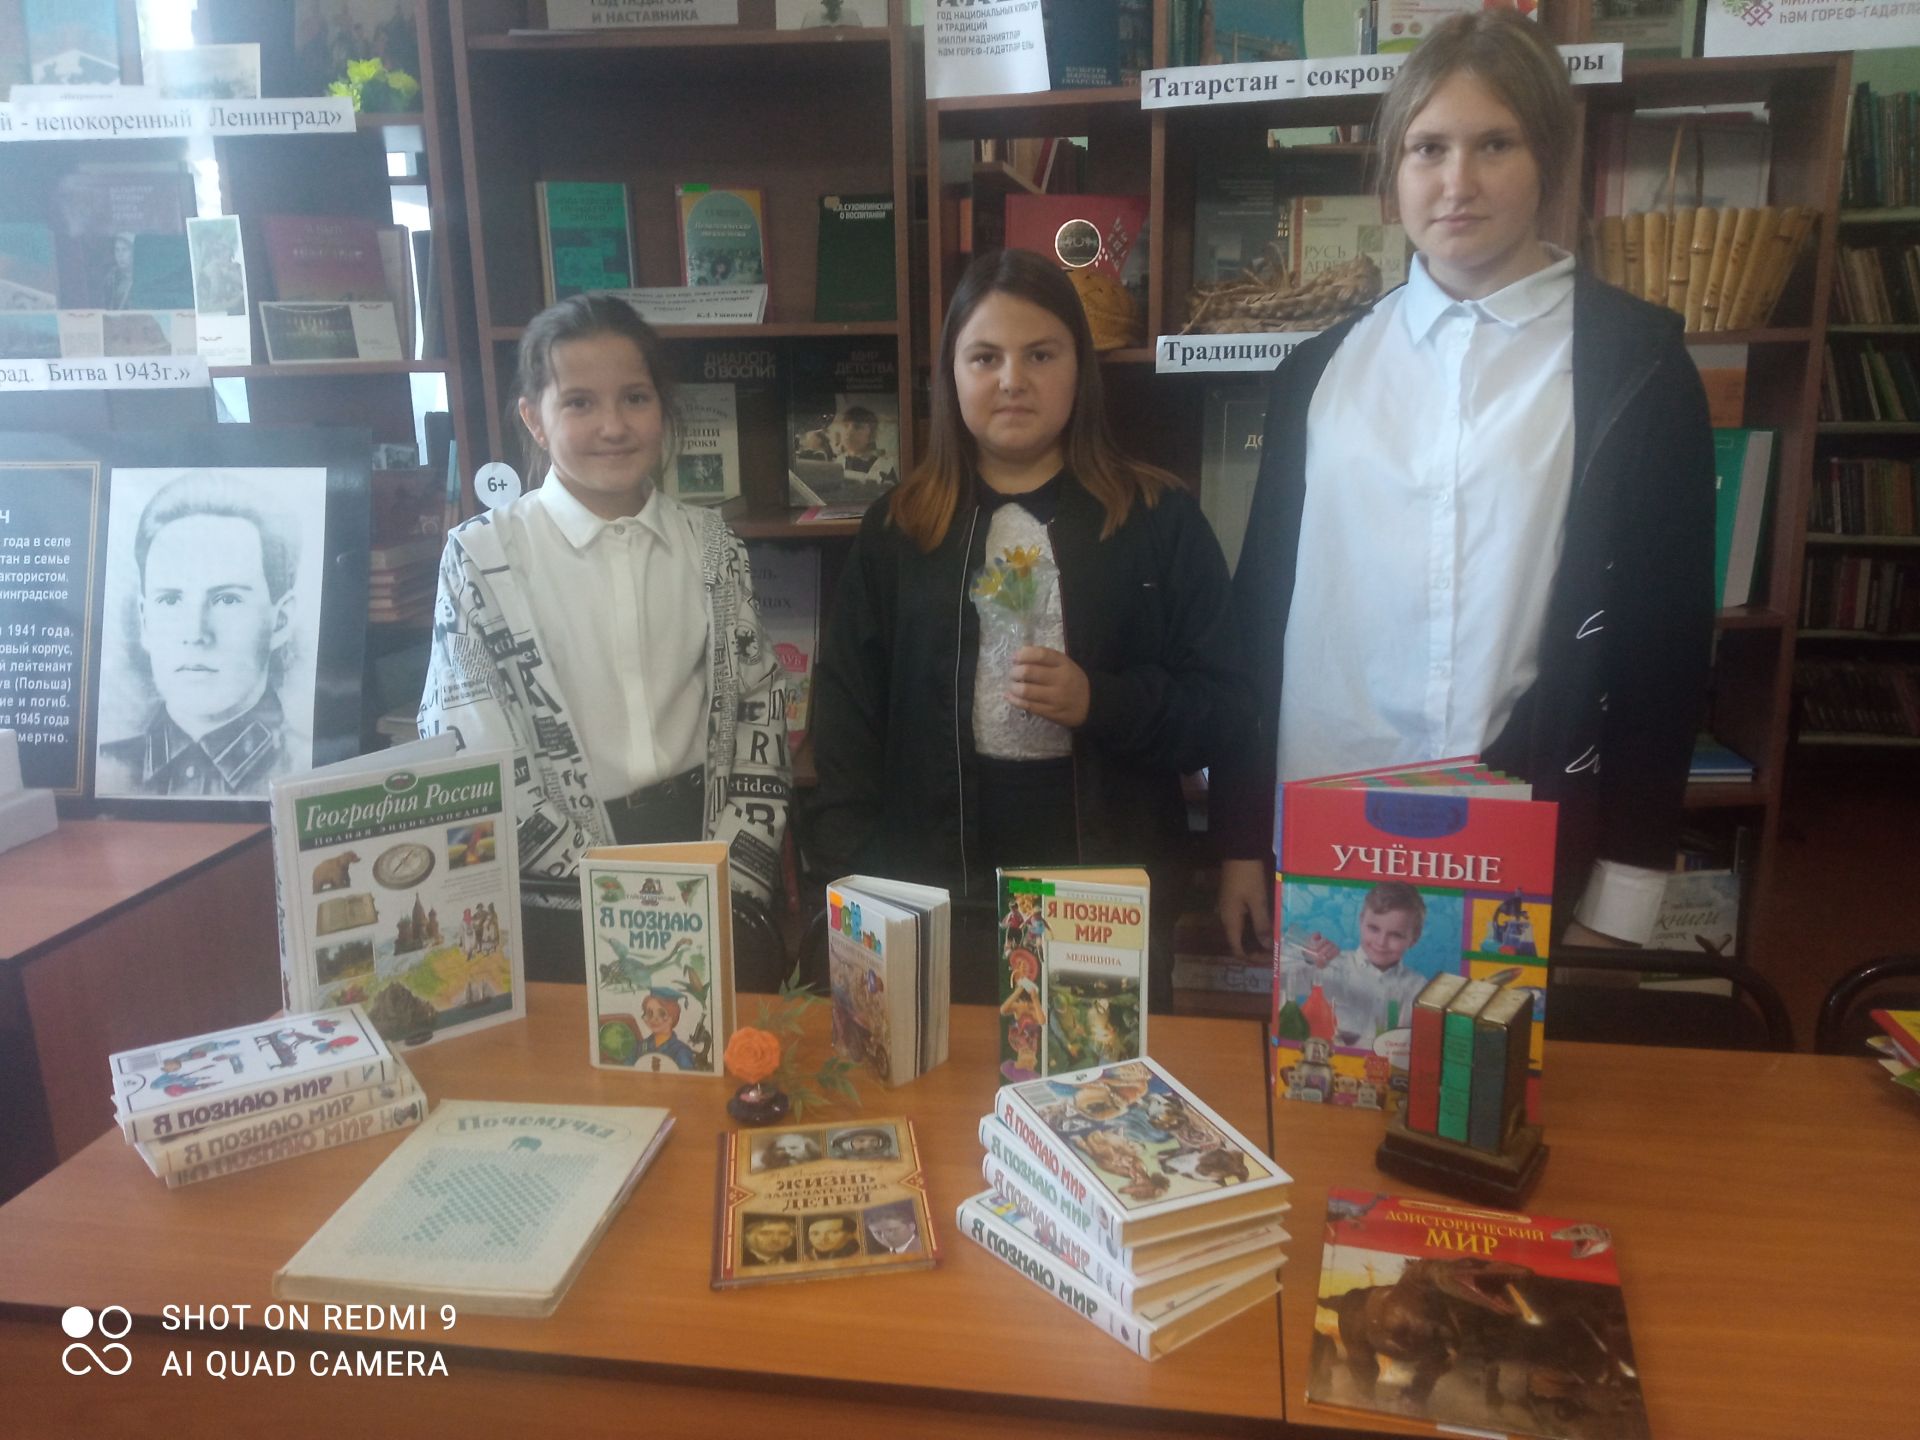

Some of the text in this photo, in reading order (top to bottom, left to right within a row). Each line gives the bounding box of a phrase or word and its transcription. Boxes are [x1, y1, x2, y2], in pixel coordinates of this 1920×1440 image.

[592, 9, 699, 24] И НАСТАВНИКА
[936, 11, 952, 21] ГОД
[954, 7, 1013, 19] НАЦИОНАЛЬНЫХ
[945, 21, 988, 32] ТРАДИЦИЙ
[1149, 73, 1278, 99] Татарстан
[1306, 64, 1401, 89] сокров
[1566, 54, 1605, 73] ры
[36, 108, 192, 135] непокоренный
[209, 106, 342, 131] Ленинград»
[1304, 244, 1346, 260] РУСЬ
[47, 363, 108, 382] Битва
[487, 476, 508, 492] 6+
[3, 536, 71, 549] года в селе
[0, 554, 70, 565] тан в семье
[8, 623, 36, 637] 1941
[41, 626, 74, 638] года.
[32, 643, 73, 657] корпус,
[9, 659, 73, 672] лейтенант
[14, 676, 72, 693] (Польша)
[18, 697, 26, 708] и
[30, 694, 70, 708] погиб.
[15, 712, 41, 726] 1945
[43, 715, 70, 727] года
[17, 732, 69, 745] мертно.
[304, 780, 495, 833] География России
[1330, 843, 1502, 884] УЧЁНЫЕ
[600, 907, 703, 933] Я ПОЗНАЮ
[1047, 902, 1142, 926] Я ПОЗНАЮ
[628, 930, 672, 950] МИР
[1074, 924, 1113, 944] МИР
[1065, 953, 1122, 967] МЕДИЦИНА
[152, 1075, 334, 1136] Я ПОЗНАЮ МИР
[183, 1094, 355, 1165] Я ПОЗНАЮ МИР
[323, 1114, 374, 1145] МИР
[457, 1114, 616, 1139] Почемучка
[1004, 1103, 1087, 1205] Я ПОЗНАЮ МИР
[776, 1173, 877, 1192] ЖИЗНЬ
[990, 1135, 1092, 1233] Я ПОЗНАЮ МИР
[781, 1192, 871, 1213] ДЕТЕЙ
[993, 1168, 1091, 1272] Я ПОЗНАЮ МИР
[1385, 1210, 1545, 1242] ДОИСТОРИЧЕСКИЙ
[1424, 1227, 1499, 1256] МИР
[971, 1218, 1099, 1319] Я ПОЗНАЮ МИР
